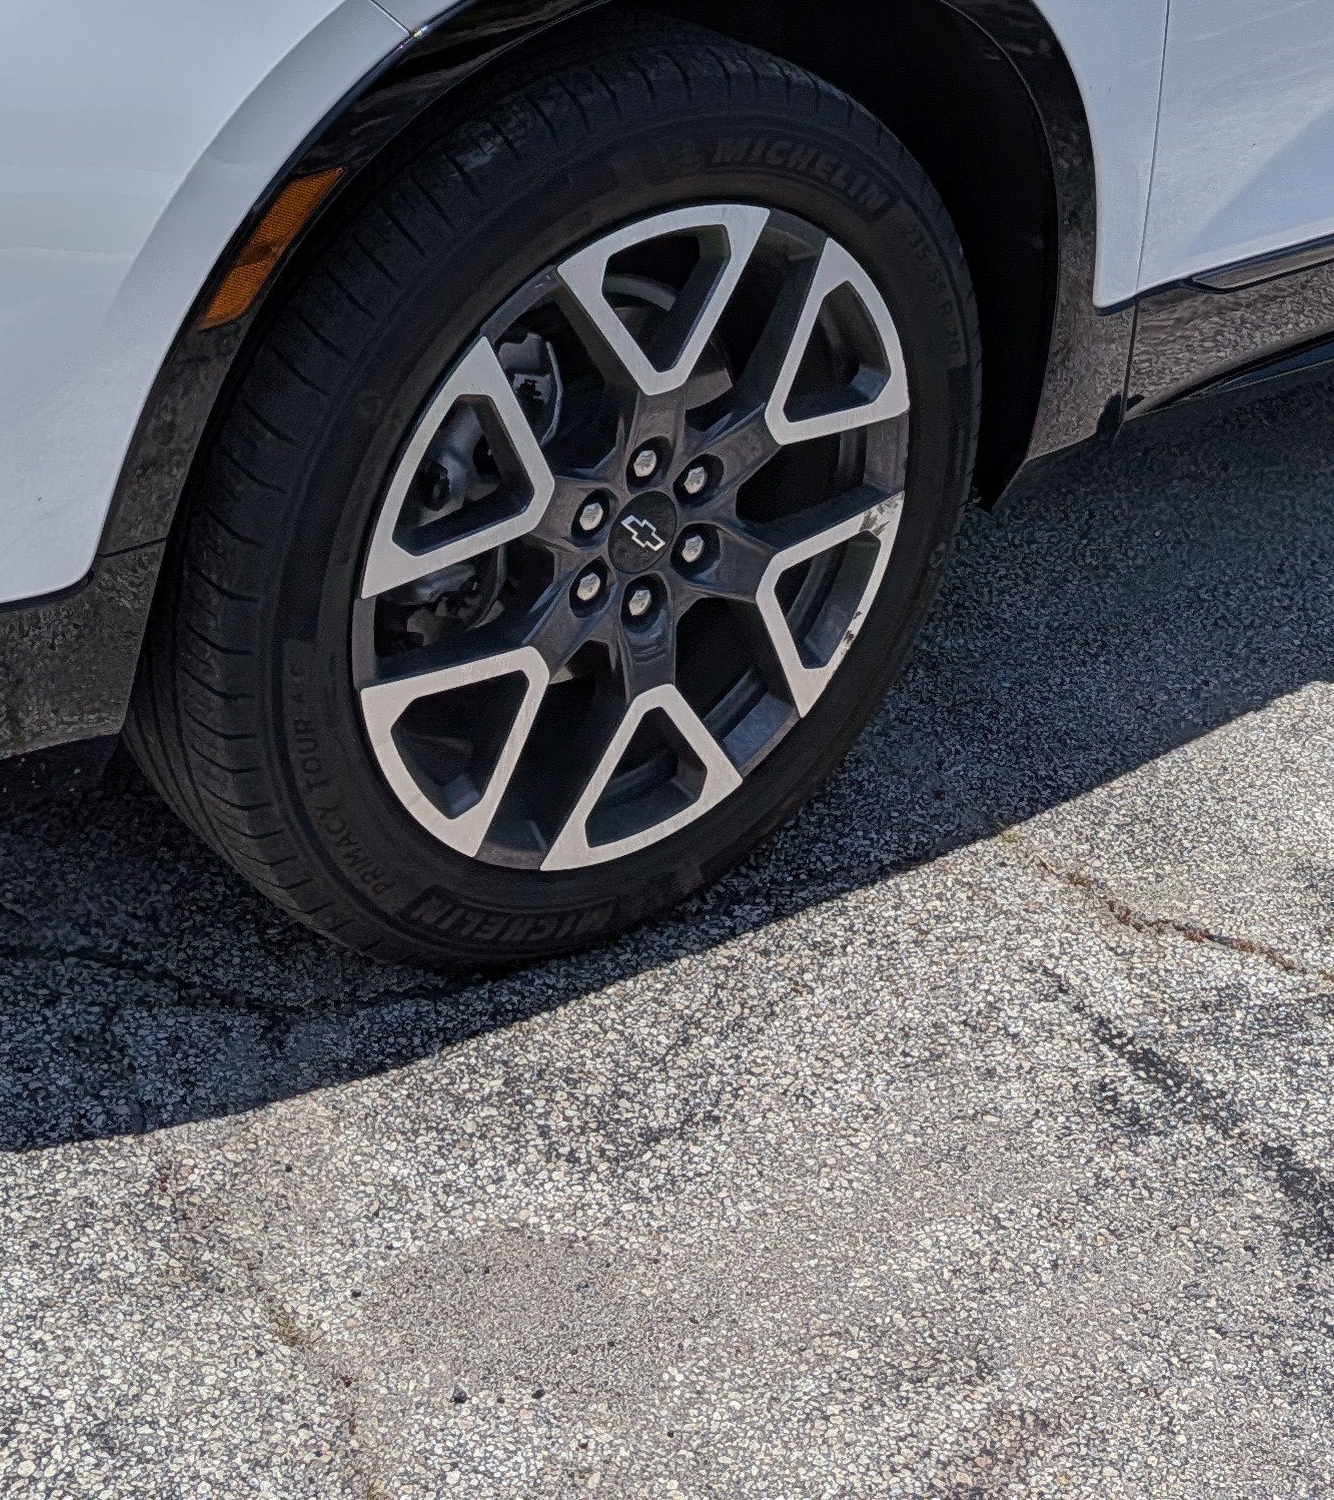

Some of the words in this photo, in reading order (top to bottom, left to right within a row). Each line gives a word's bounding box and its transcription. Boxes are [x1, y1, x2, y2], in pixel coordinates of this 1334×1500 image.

[710, 136, 892, 215] MICHELIN
[293, 719, 330, 793] TOUR
[314, 806, 396, 896] PRIMACY
[410, 894, 616, 942] MICHELIN
